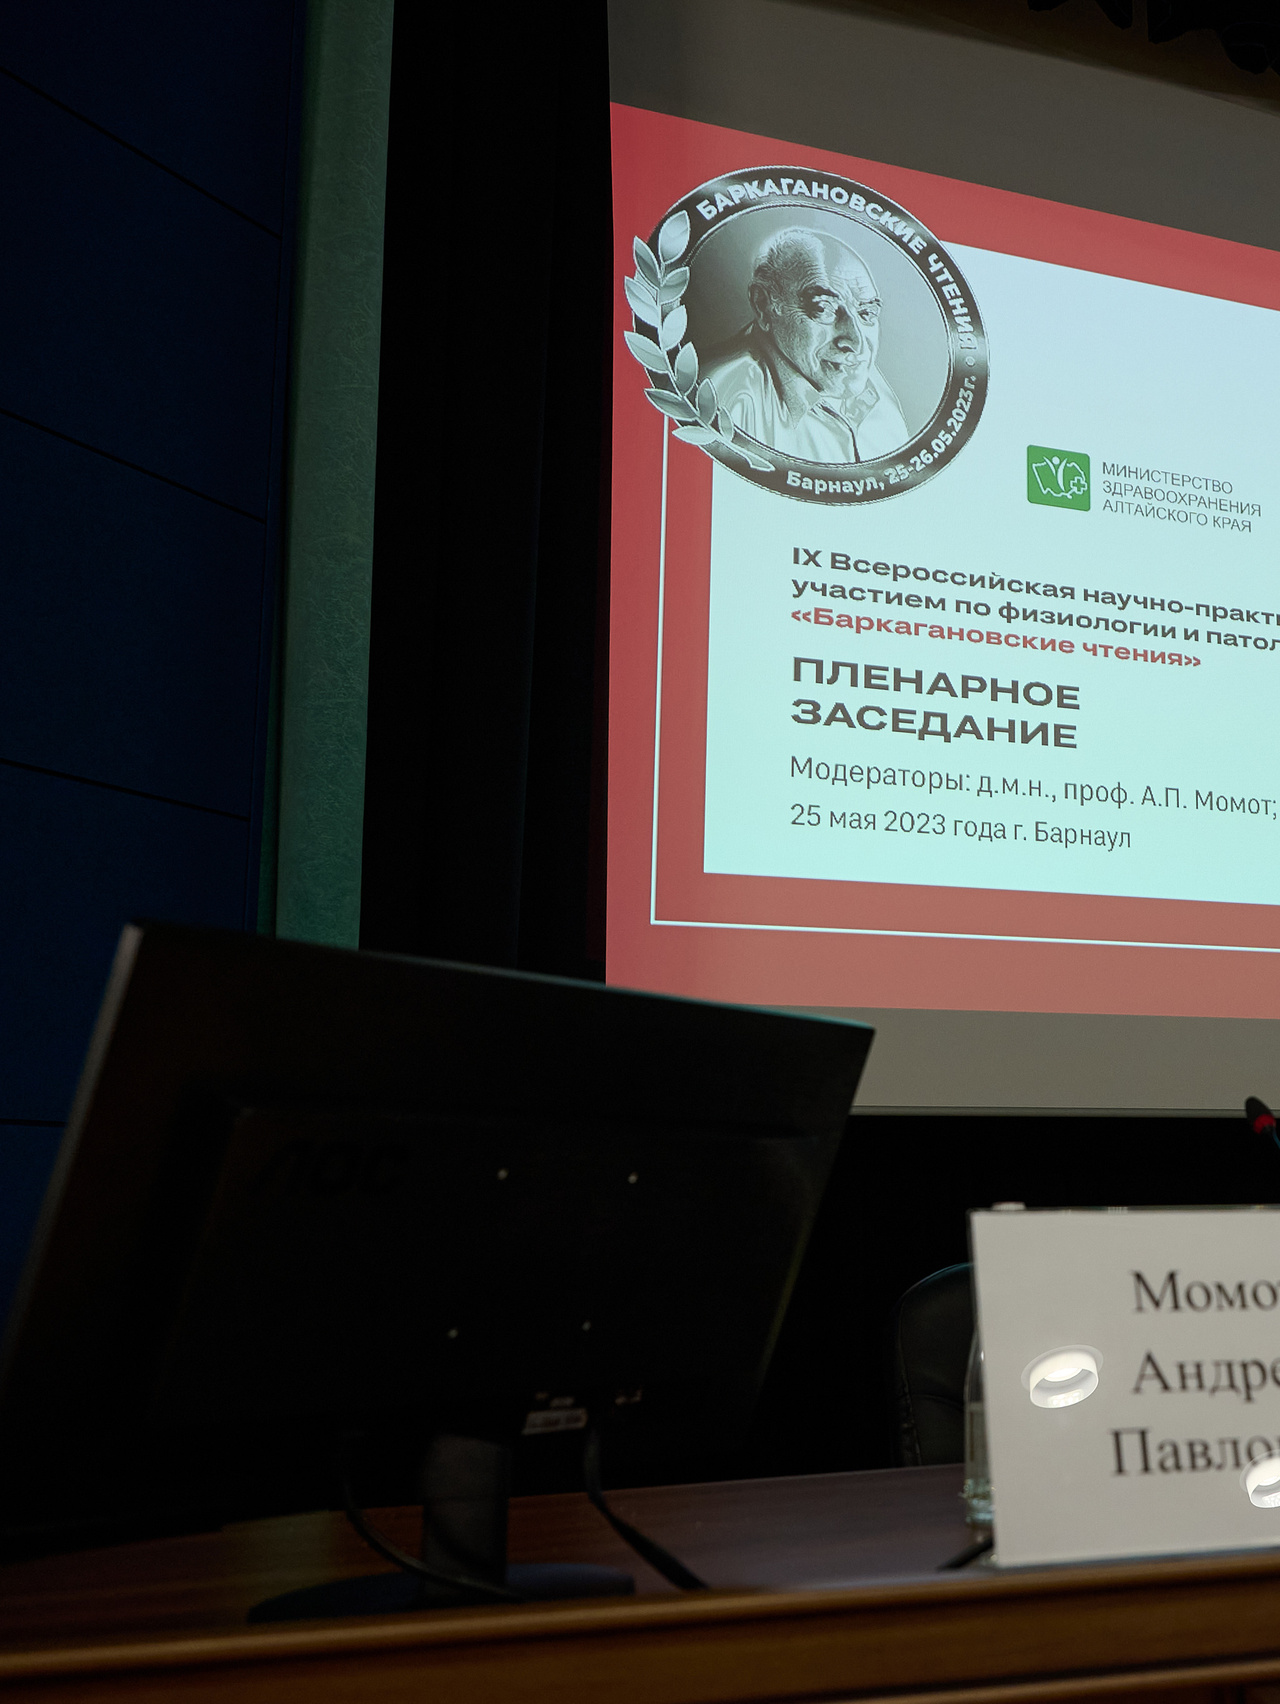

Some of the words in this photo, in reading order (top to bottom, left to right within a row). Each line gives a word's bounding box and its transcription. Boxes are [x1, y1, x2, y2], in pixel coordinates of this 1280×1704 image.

[697, 177, 929, 256] БАРКАГАНОВСКИЕ
[927, 251, 976, 350] ЧТЕНИЯ
[786, 469, 886, 496] Барнаул,
[1103, 462, 1233, 494] МИНИСТЕРСТВО
[1103, 480, 1261, 517] ЗДРАВООХРАНЕНИЯ
[1103, 499, 1208, 526] АЛТАЙСКОГО
[1213, 516, 1251, 533] КРАЯ
[793, 547, 822, 567] IX
[831, 552, 1075, 599] Всероссийская
[792, 579, 945, 611] участием
[956, 600, 990, 616] по
[999, 601, 1176, 639] физиологии
[1184, 628, 1199, 641] и
[791, 607, 1075, 653] «Баркагановские
[1083, 642, 1201, 667] чтения»
[794, 657, 1080, 710] ПЛЕНАРНОЕ
[791, 699, 1077, 749] ЗАСЕДАНИЕ
[791, 756, 970, 794] Модераторы:
[977, 776, 1056, 802] д.м.н.,
[1065, 782, 1134, 809] проф.
[1141, 786, 1187, 808] А.П.
[1196, 790, 1276, 820] Момот;
[791, 804, 820, 826] 25
[830, 811, 875, 830] мая
[884, 810, 945, 835] 2023
[954, 820, 1006, 842] года
[1014, 824, 1026, 841] г.
[1035, 821, 1130, 852] Барнаул
